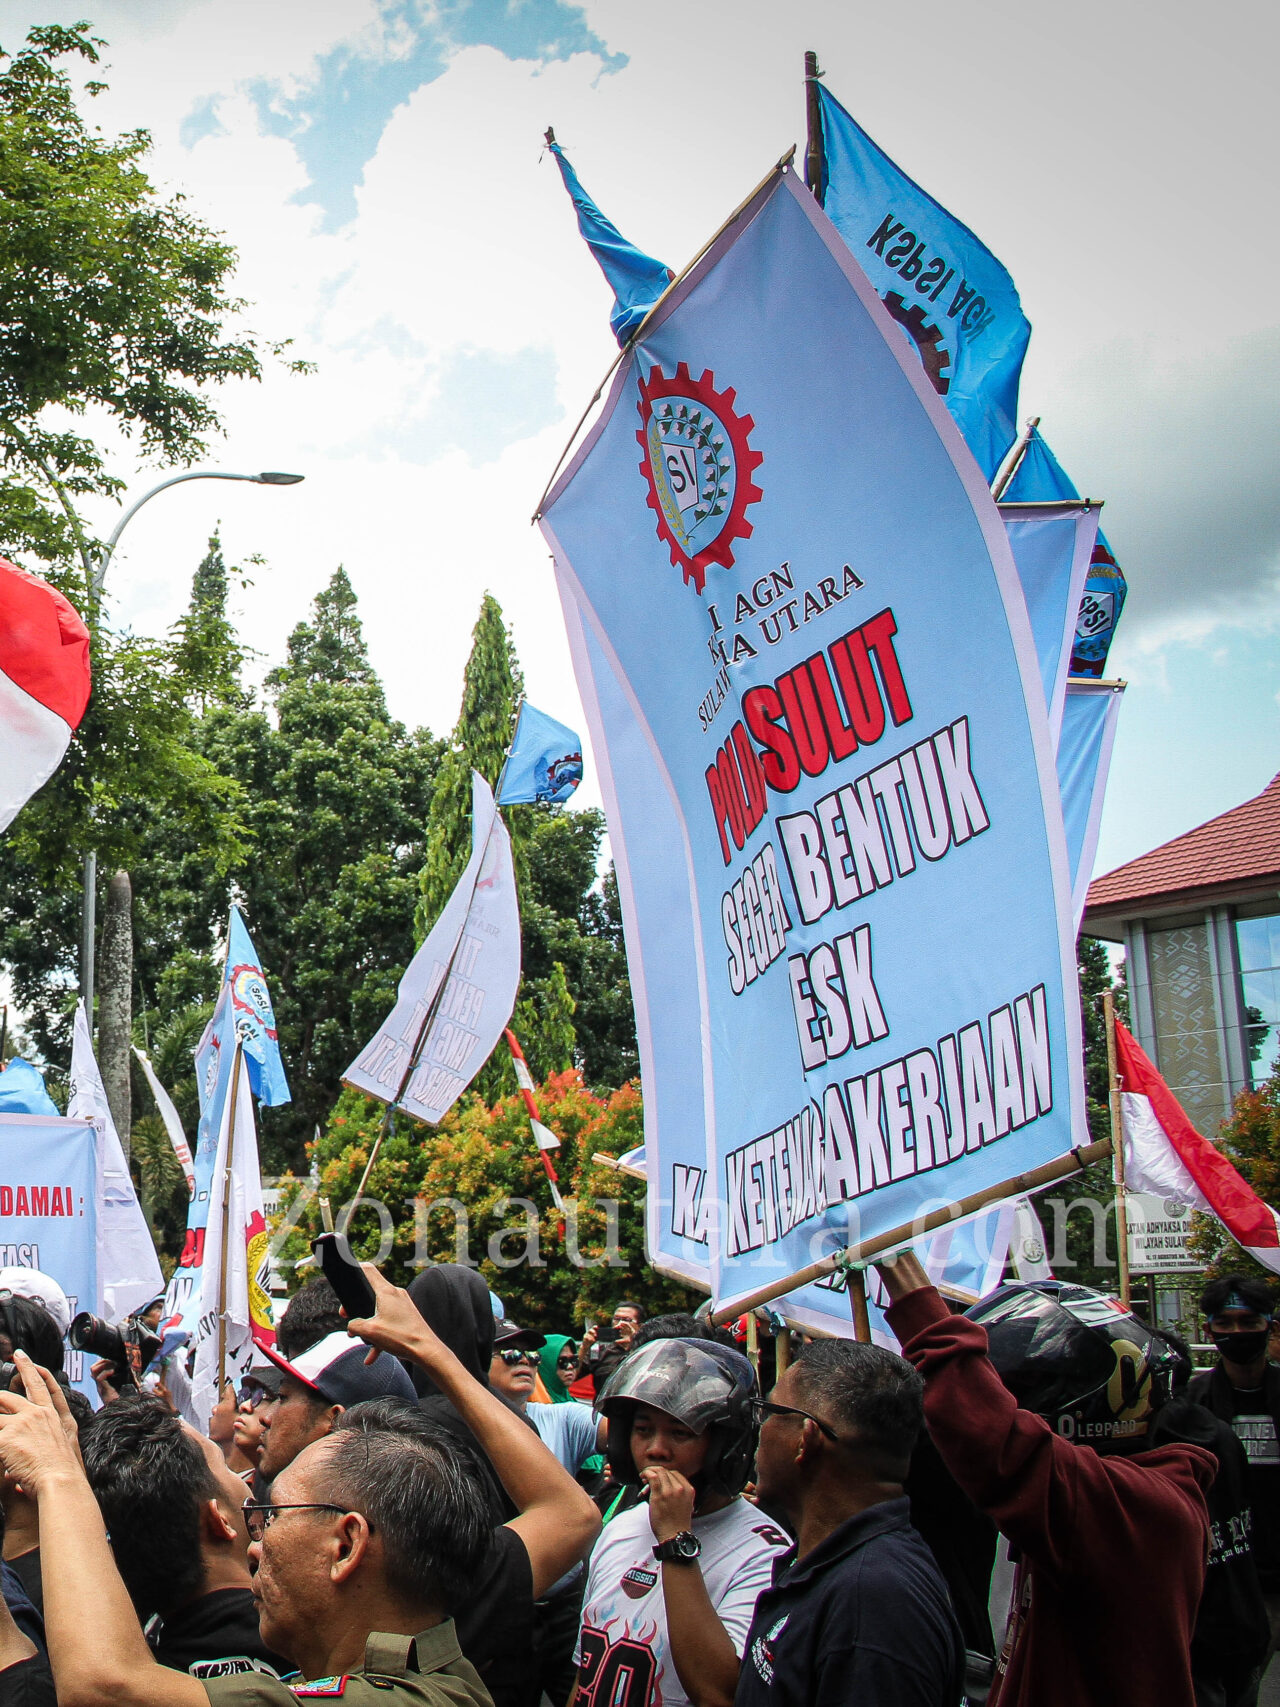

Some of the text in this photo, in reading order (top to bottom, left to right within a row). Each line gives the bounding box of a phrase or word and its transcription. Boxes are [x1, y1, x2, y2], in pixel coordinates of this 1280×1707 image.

[733, 561, 796, 624] AGN
[758, 563, 867, 646] UTARA
[740, 607, 914, 794] SULUT
[775, 715, 991, 926] BENTUK
[0, 1185, 73, 1217] DAMAI
[1134, 1236, 1163, 1249] WILAYAH
[1146, 1220, 1181, 1234] ADHYAKSA
[1077, 1420, 1137, 1438] LEOPARD
